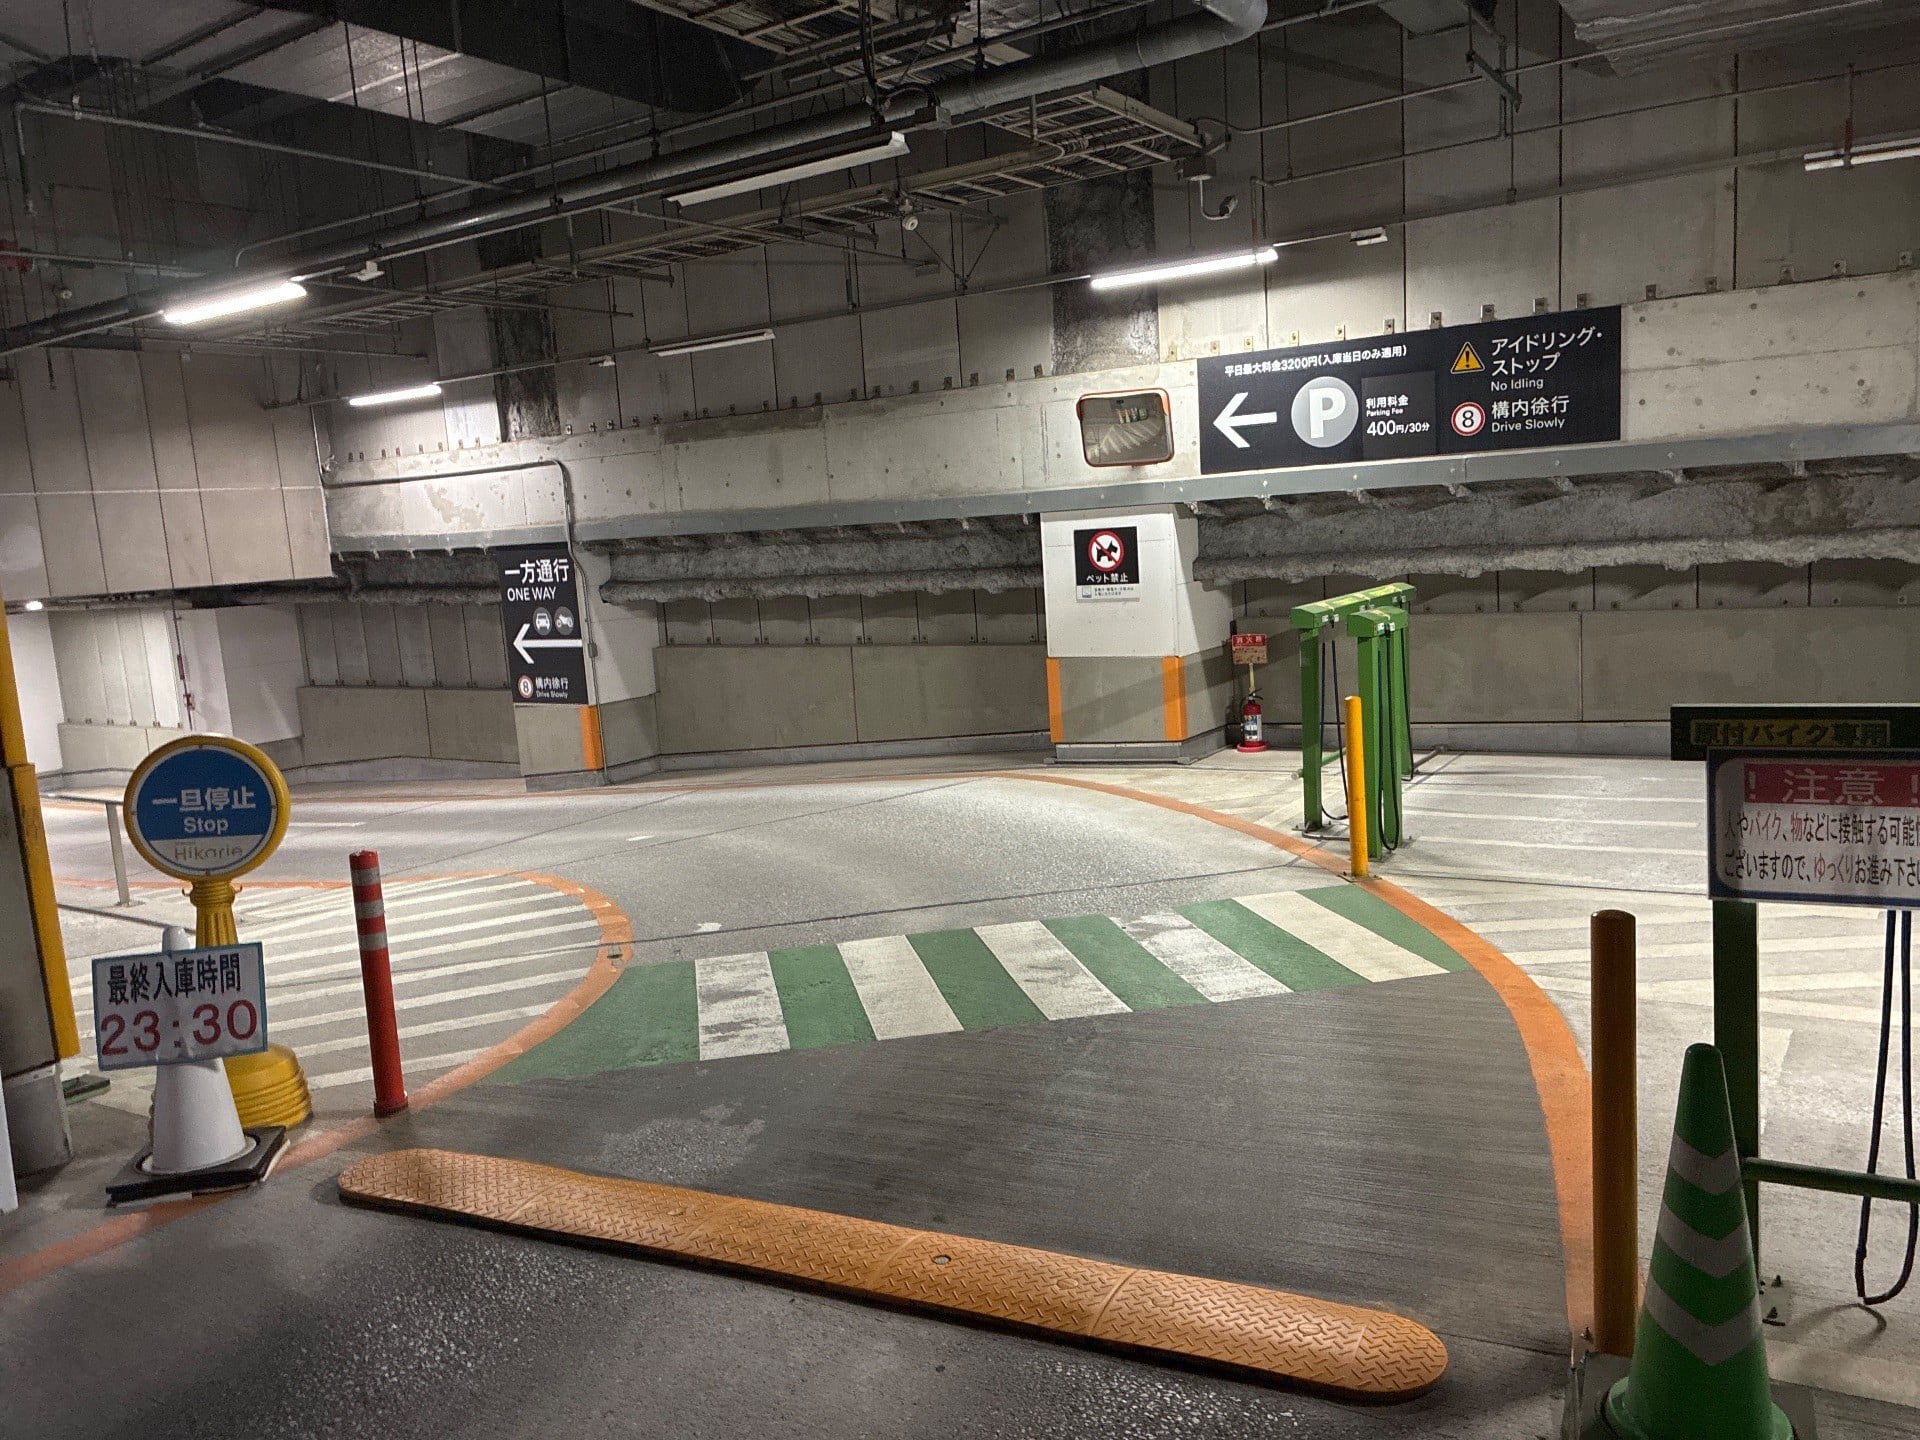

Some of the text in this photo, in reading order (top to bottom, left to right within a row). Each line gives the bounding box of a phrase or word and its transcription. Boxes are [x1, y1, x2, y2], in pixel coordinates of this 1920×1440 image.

[1491, 351, 1561, 377] ストップ
[1490, 378, 1544, 392] No Idling
[1365, 394, 1409, 409] 利用料金
[1491, 395, 1570, 420] 構内徐行
[1309, 387, 1346, 439] P
[1366, 407, 1404, 417] Parking Fee
[1462, 410, 1475, 428] 8
[1366, 419, 1431, 437] 400円/30分
[1491, 417, 1566, 433] Drive Slowly
[504, 558, 569, 584] 一方通行
[1086, 572, 1129, 584] ペット禁止
[507, 586, 557, 602] ONE WAY
[1782, 767, 1885, 805] 注意
[152, 785, 256, 812] 一旦停止
[183, 816, 229, 835] Stop
[174, 844, 243, 861] Hikarie
[107, 952, 242, 1006] 最終入庫時間
[101, 999, 258, 1057] 23:30
